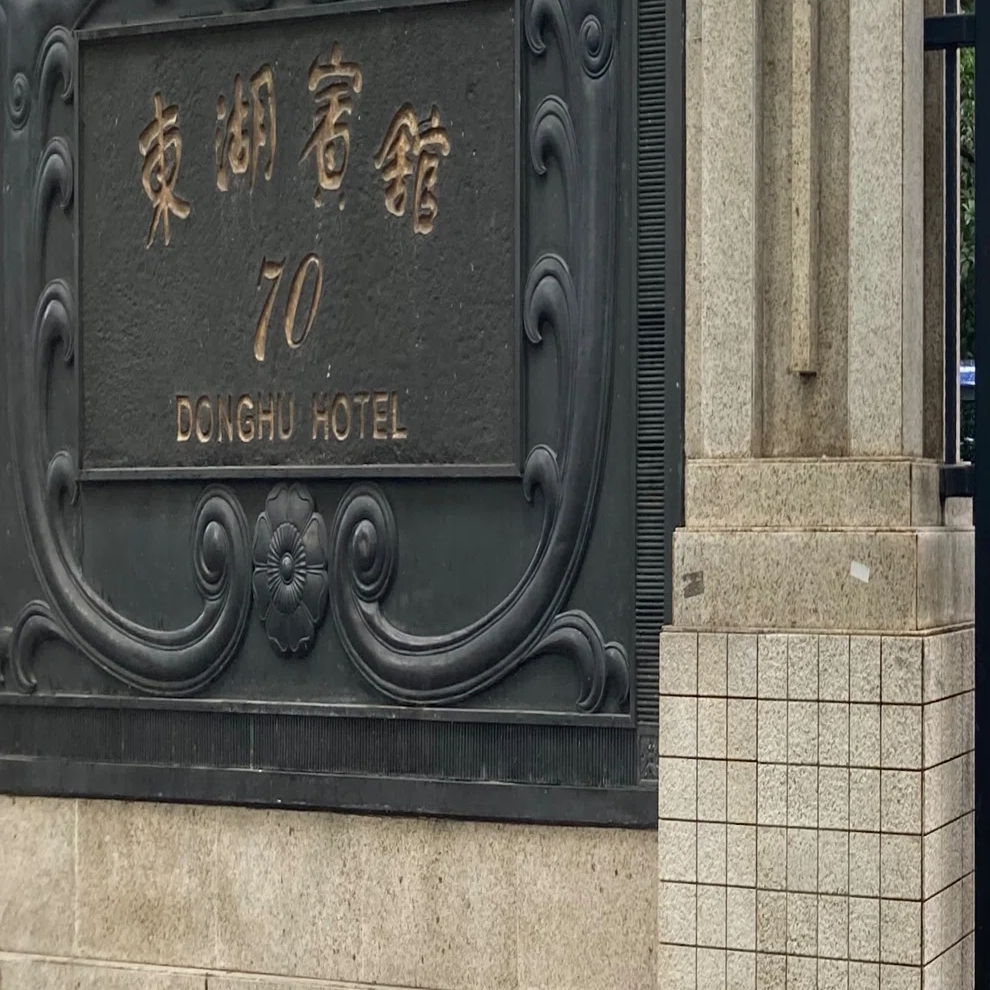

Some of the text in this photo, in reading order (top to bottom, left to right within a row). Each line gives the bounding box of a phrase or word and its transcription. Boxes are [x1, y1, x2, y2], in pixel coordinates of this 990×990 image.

[254, 252, 323, 362] 70
[176, 391, 407, 442] DONGHU HOTEL
